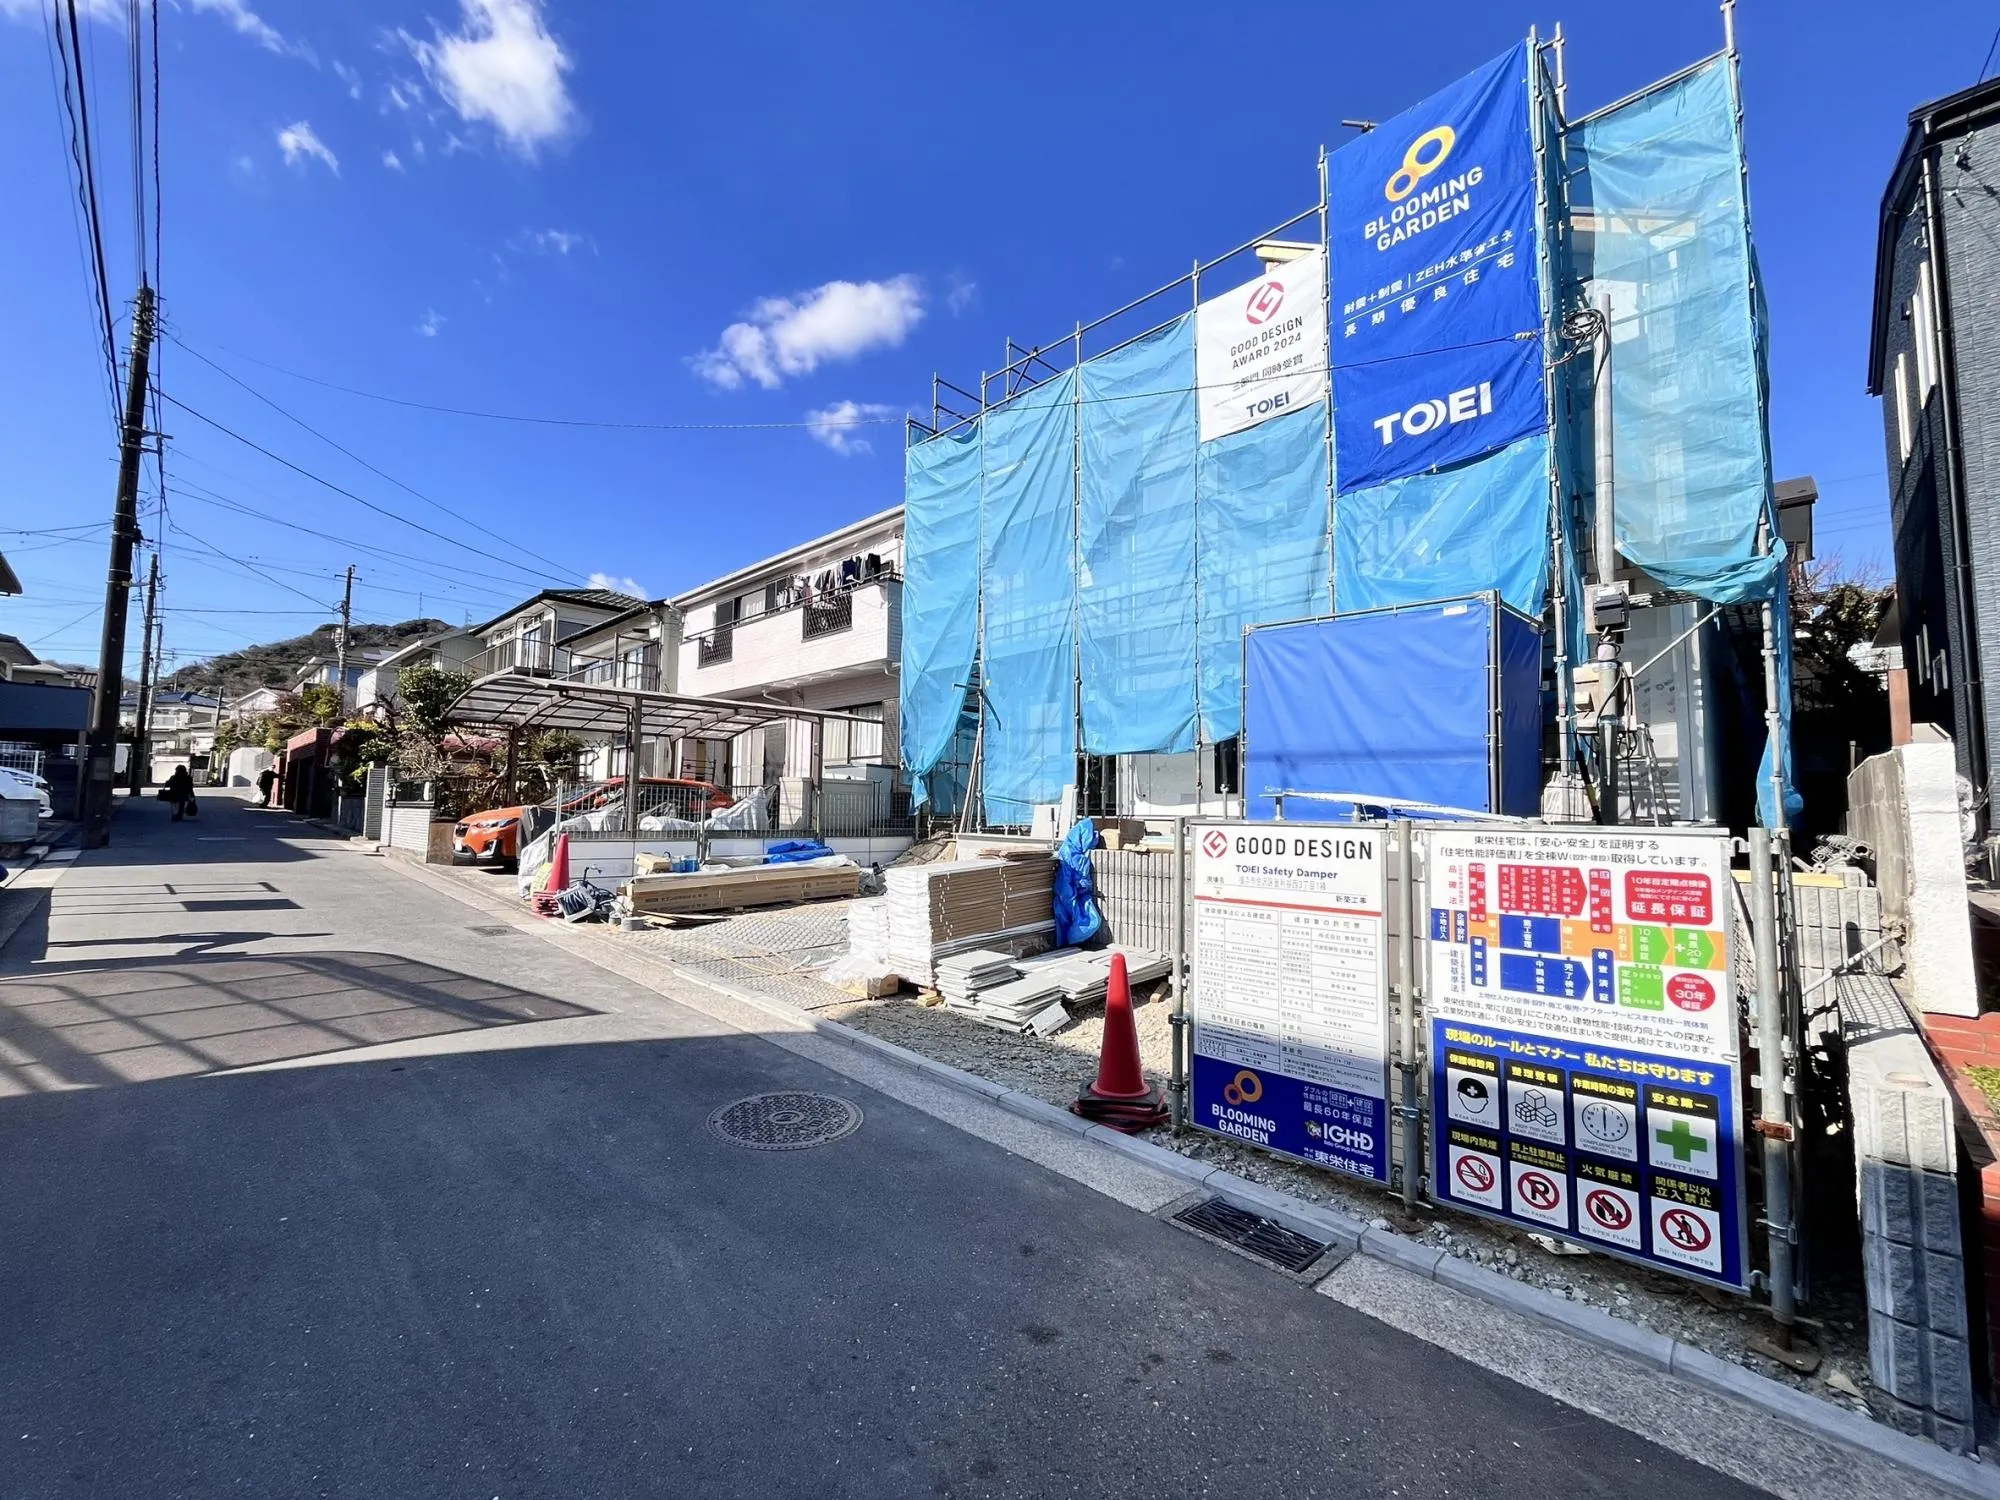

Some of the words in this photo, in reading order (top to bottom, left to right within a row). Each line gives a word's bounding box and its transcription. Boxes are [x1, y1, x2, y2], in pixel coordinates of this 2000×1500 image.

[1364, 166, 1483, 240] BLOOMING
[1376, 193, 1470, 252] GARDEN
[1344, 253, 1515, 338] 長期優良住宅
[1230, 337, 1259, 357] GOOD
[1261, 315, 1303, 343] DESIGN
[1232, 345, 1270, 370] AWARD
[1274, 332, 1302, 352] 2024
[1373, 381, 1492, 446] TOEI
[1236, 837, 1286, 856] GOOD
[1295, 840, 1373, 860] DESIGN
[1263, 866, 1294, 880] Safety
[1297, 868, 1338, 880] Damper
[1336, 895, 1367, 905] 新築工事
[1631, 902, 1706, 918] 延長保証
[1639, 928, 1651, 960] 10年保証
[1564, 963, 1574, 997] 完了検査
[1675, 989, 1706, 1001] 30年
[1446, 1029, 1580, 1059] 現場のルールとマナー
[1584, 1052, 1714, 1086] 私たちは守ります
[1511, 1067, 1558, 1083] 整理整頓
[1303, 1101, 1373, 1128] 最長60年保証
[1652, 1093, 1708, 1109] 安全第一
[1212, 1103, 1276, 1133] BLOOMING
[1219, 1119, 1269, 1145] GARDEN
[1314, 1150, 1375, 1178] 東栄住宅
[1581, 1163, 1633, 1184] 火気厳禁
[1655, 1176, 1711, 1197] 関係者以外
[1655, 1186, 1712, 1208] 立入禁止
